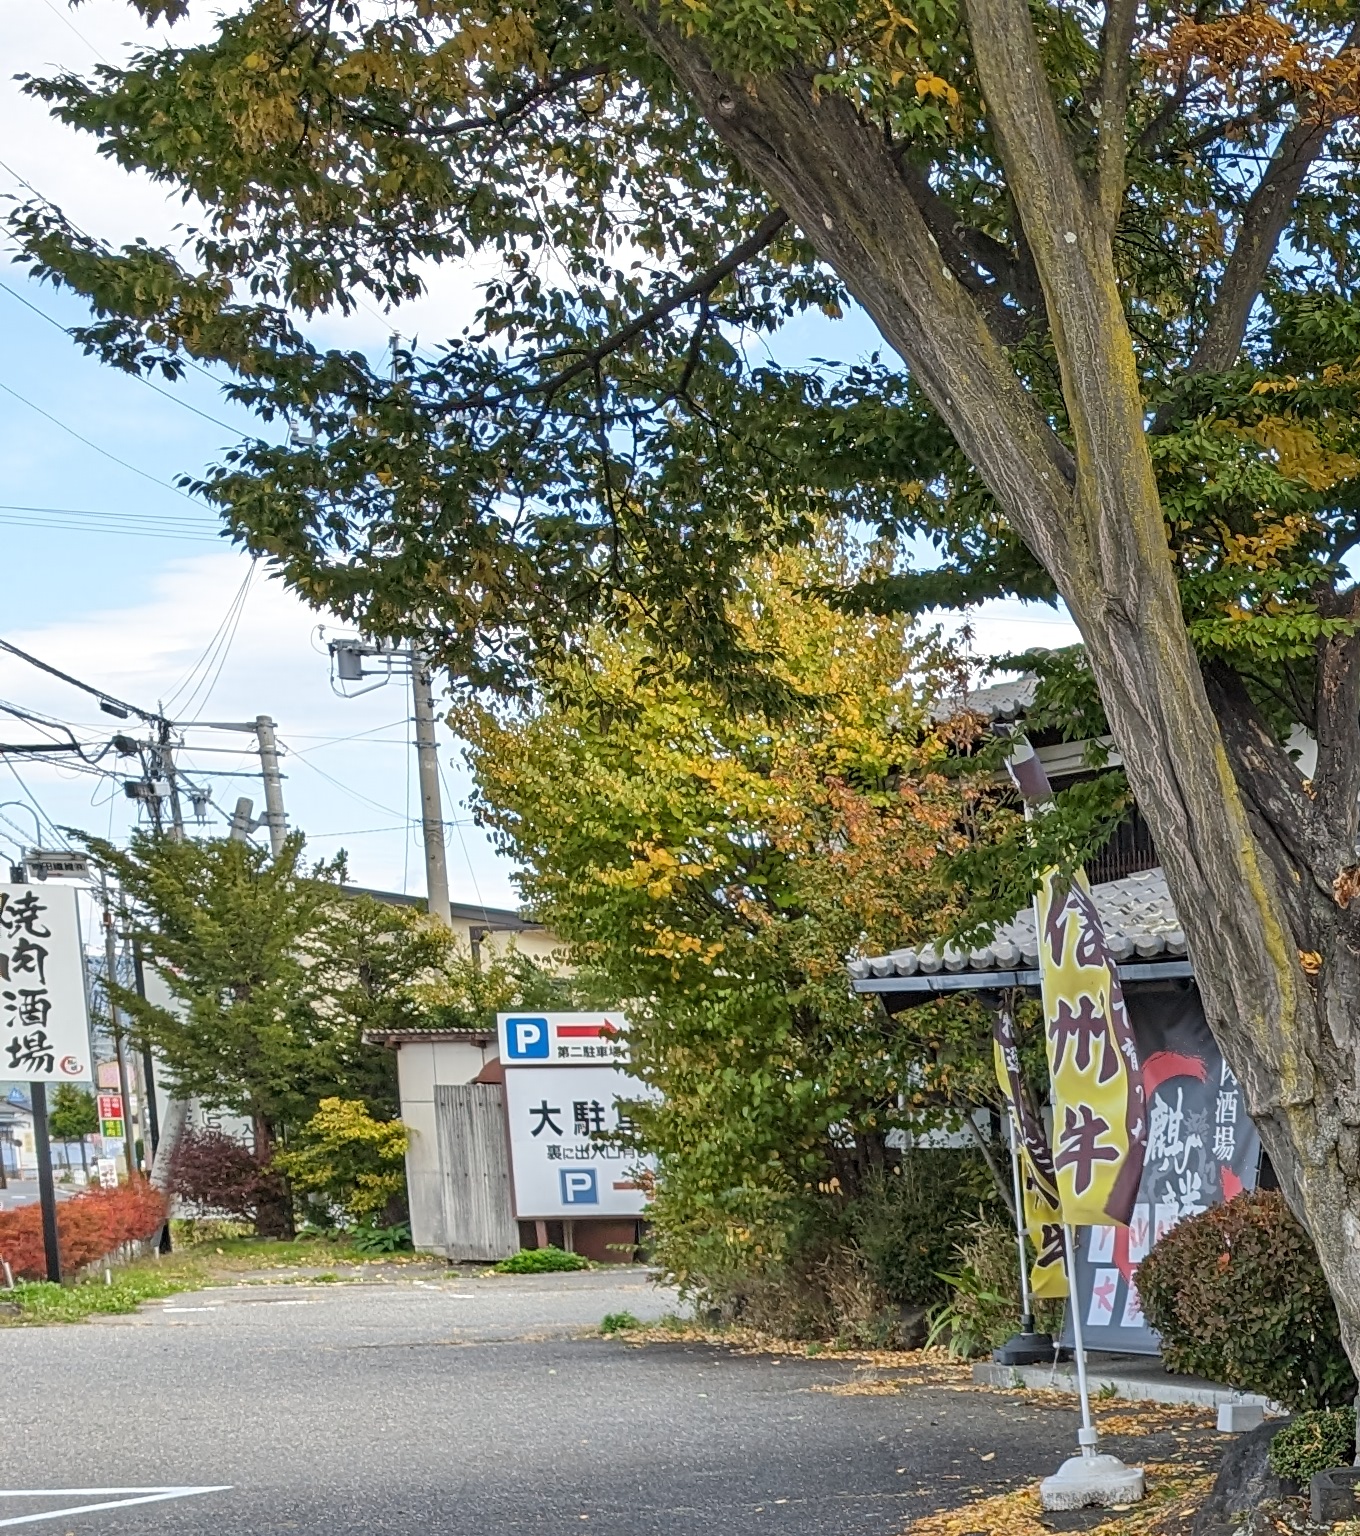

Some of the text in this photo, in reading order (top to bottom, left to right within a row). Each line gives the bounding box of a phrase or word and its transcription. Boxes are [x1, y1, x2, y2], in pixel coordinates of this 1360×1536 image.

[0, 890, 55, 1075] 焼肉酒場
[516, 1024, 541, 1054] P
[557, 1046, 626, 1059] 第二駐車場
[565, 1172, 592, 1202] P
